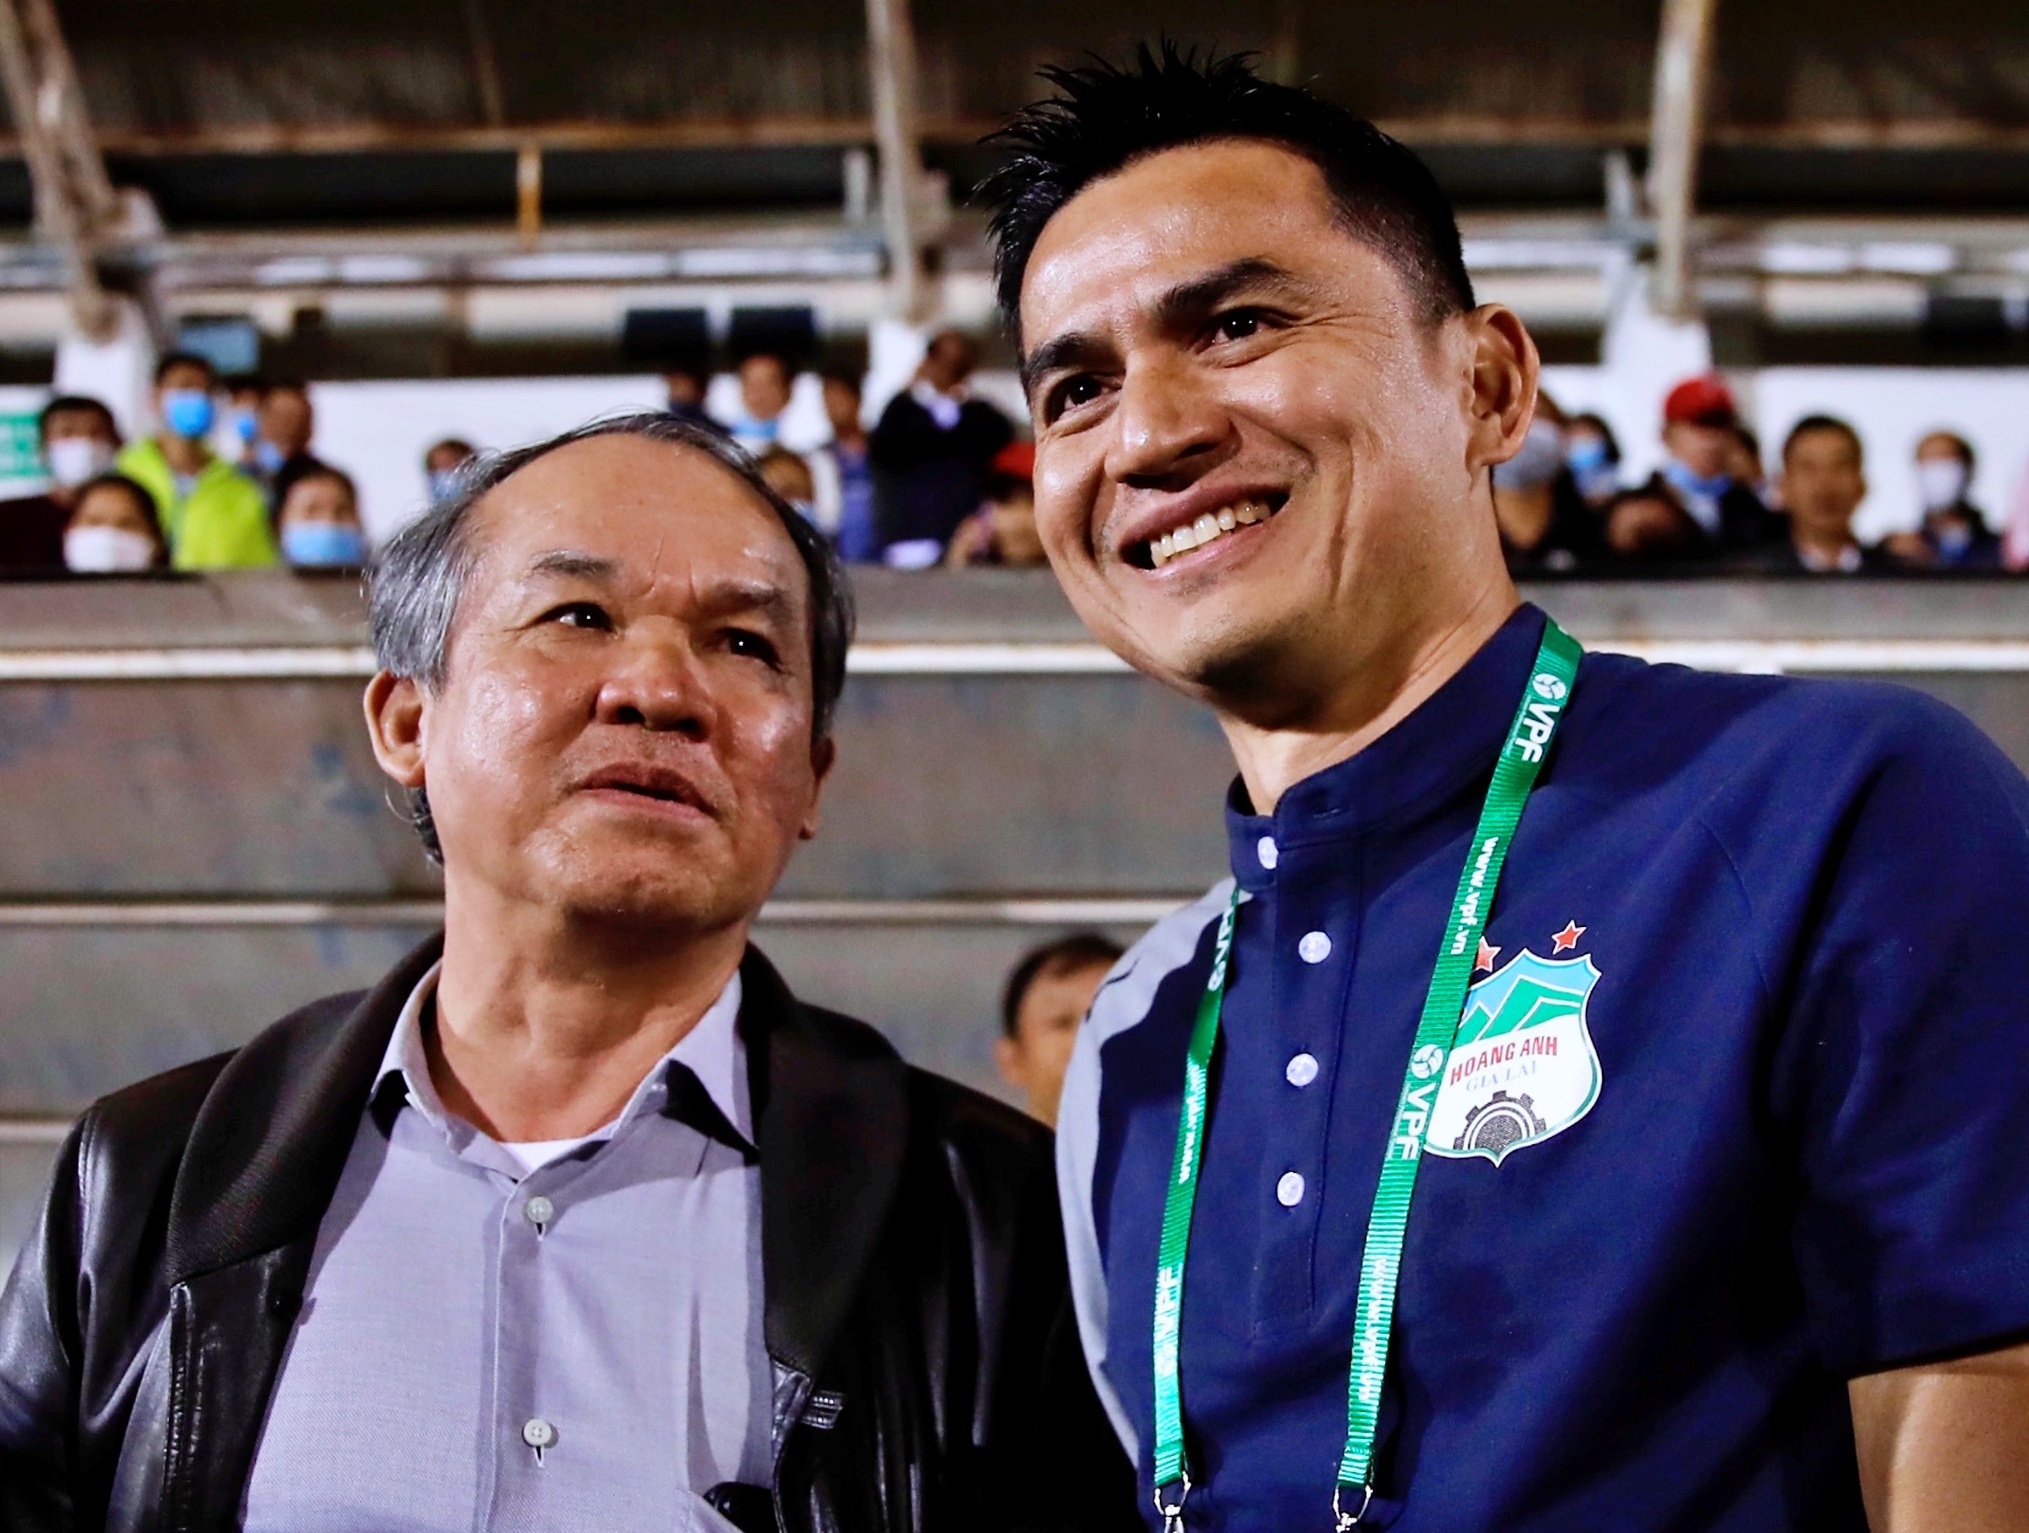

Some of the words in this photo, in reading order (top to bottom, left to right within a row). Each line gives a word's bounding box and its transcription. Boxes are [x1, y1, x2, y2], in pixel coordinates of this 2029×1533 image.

[1514, 702, 1561, 763] VPF
[1450, 836, 1499, 955] www.vpf.vn
[1466, 1073, 1498, 1091] GIA
[1506, 1060, 1536, 1080] LAI
[1520, 1035, 1558, 1056] ANH
[1396, 1082, 1436, 1160] VPF
[1154, 1266, 1178, 1342] VPF
